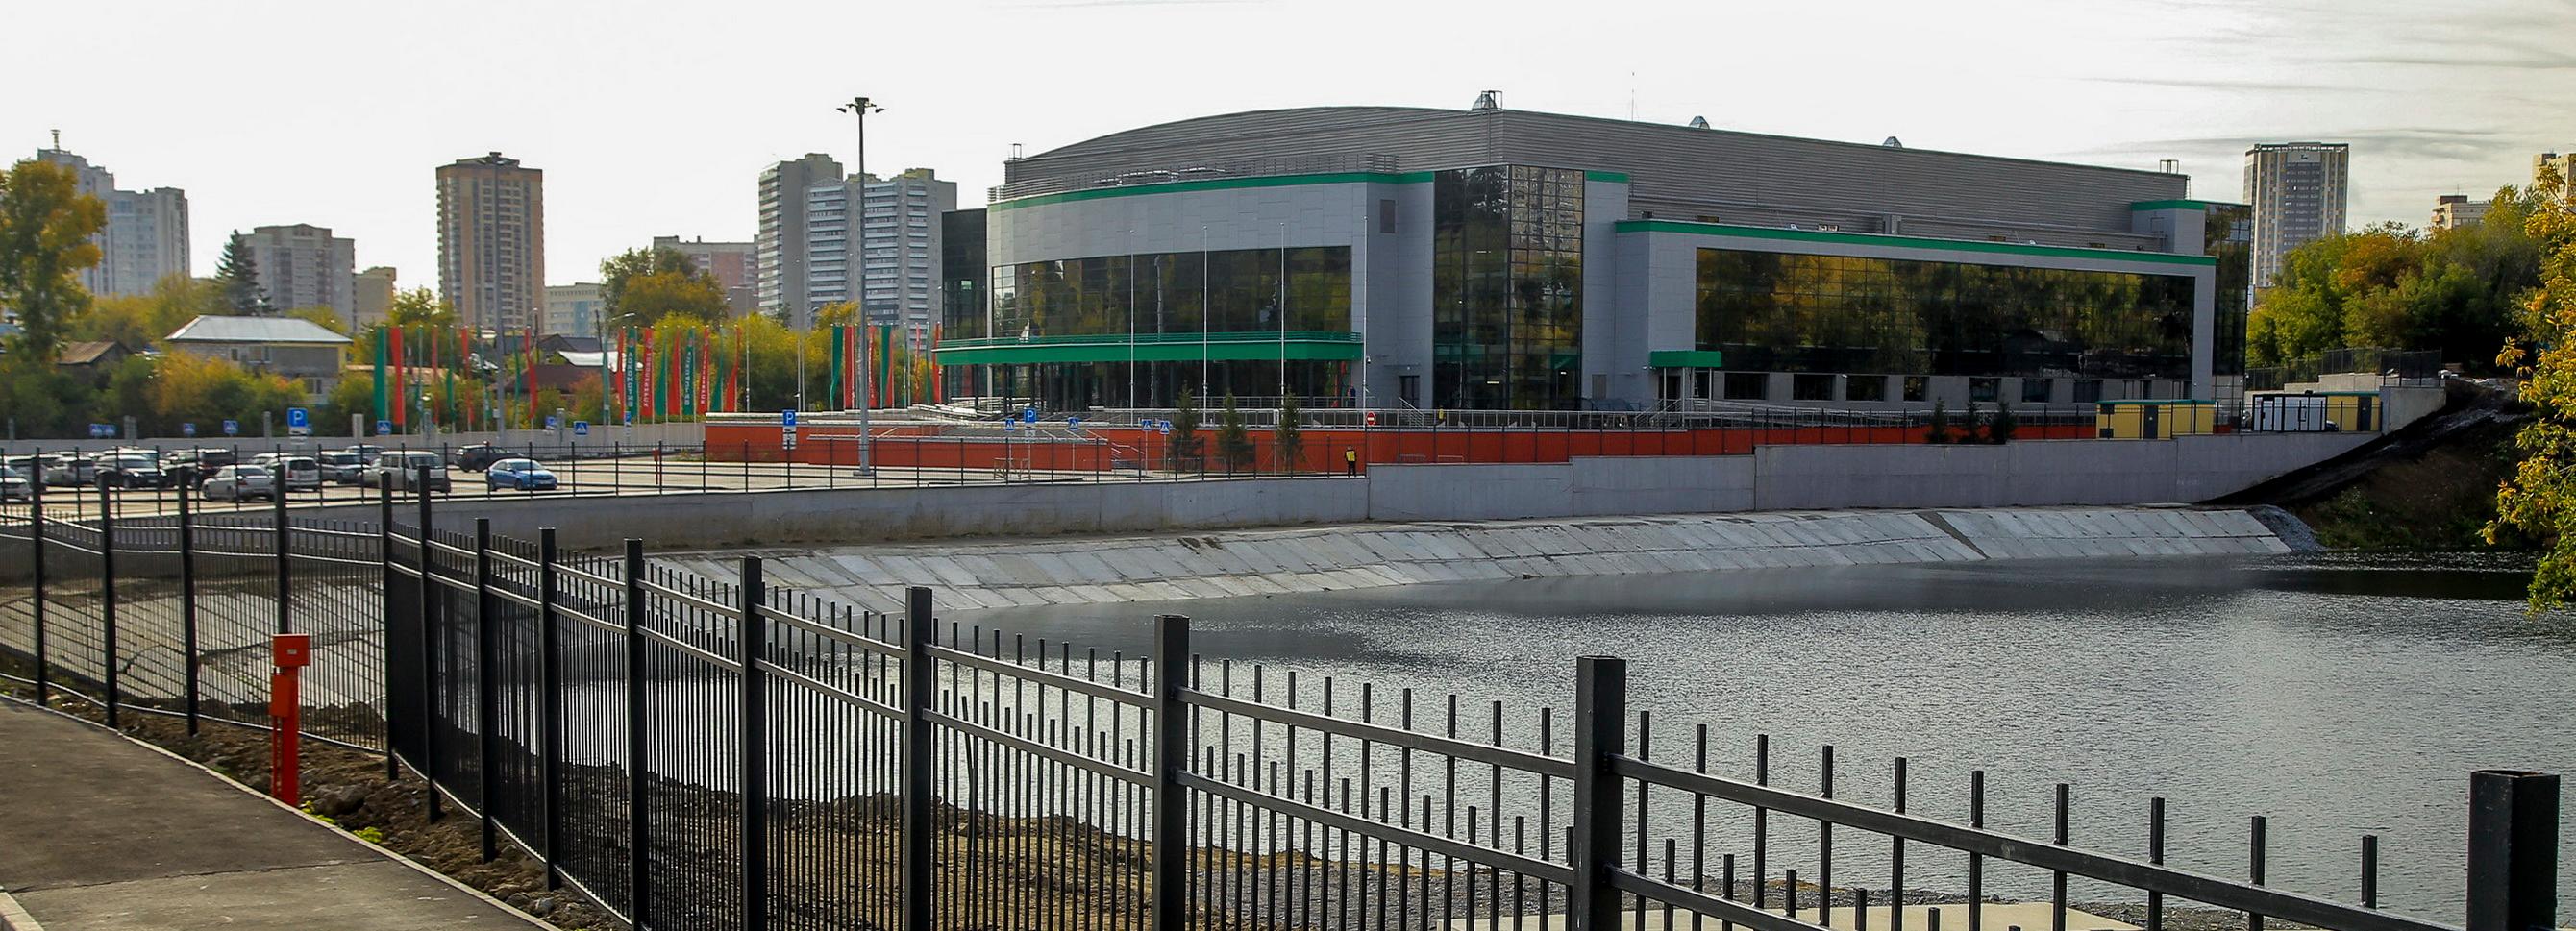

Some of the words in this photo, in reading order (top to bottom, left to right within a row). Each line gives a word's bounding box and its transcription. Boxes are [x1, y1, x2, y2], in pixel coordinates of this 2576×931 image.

[294, 410, 303, 424] P
[786, 412, 794, 424] P
[1027, 410, 1034, 422] P
